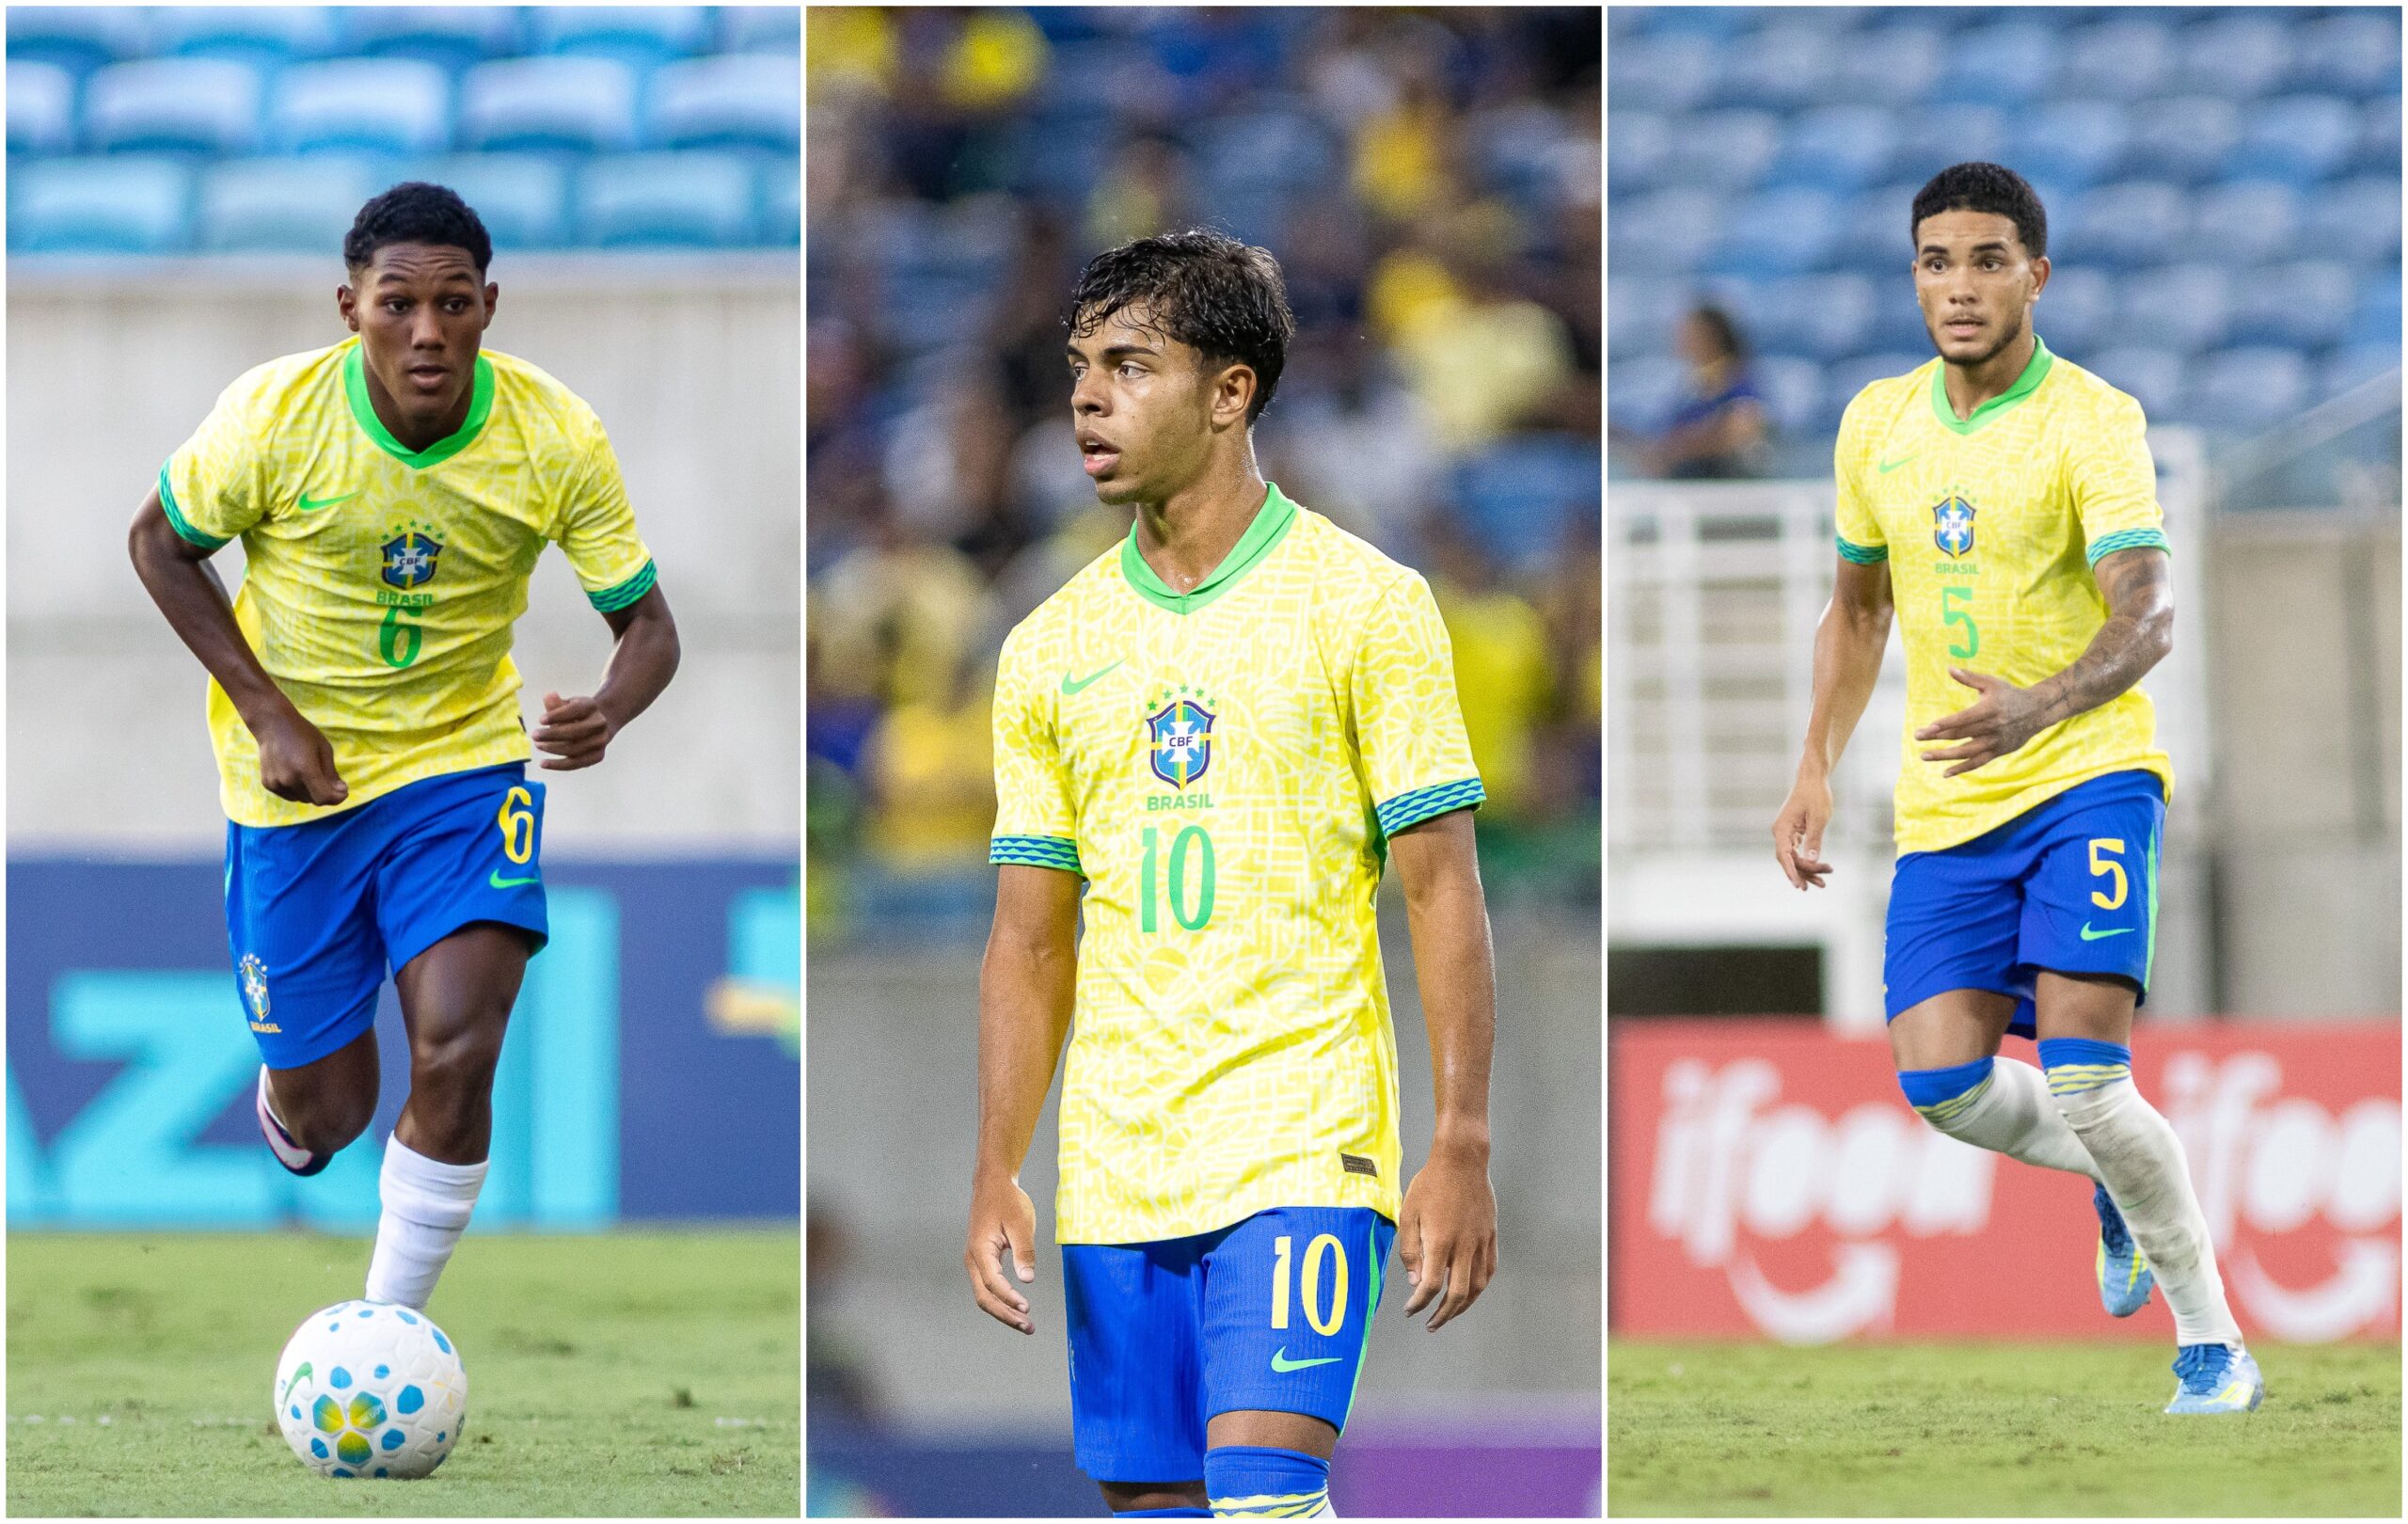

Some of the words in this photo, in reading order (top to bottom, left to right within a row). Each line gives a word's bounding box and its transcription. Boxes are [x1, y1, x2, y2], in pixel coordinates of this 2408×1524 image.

[1946, 520, 1963, 530] CBF
[399, 555, 421, 566] CBF
[1935, 563, 1980, 575] BRASIL
[376, 591, 435, 607] BRASIL
[379, 605, 422, 669] 6
[1942, 587, 1979, 659] 5
[1168, 736, 1194, 748] CBF
[1147, 793, 1214, 812] BRASIL
[498, 786, 534, 865] 6
[1141, 824, 1216, 933] 10
[2088, 837, 2128, 911] 5
[1271, 1233, 1349, 1337] 10
